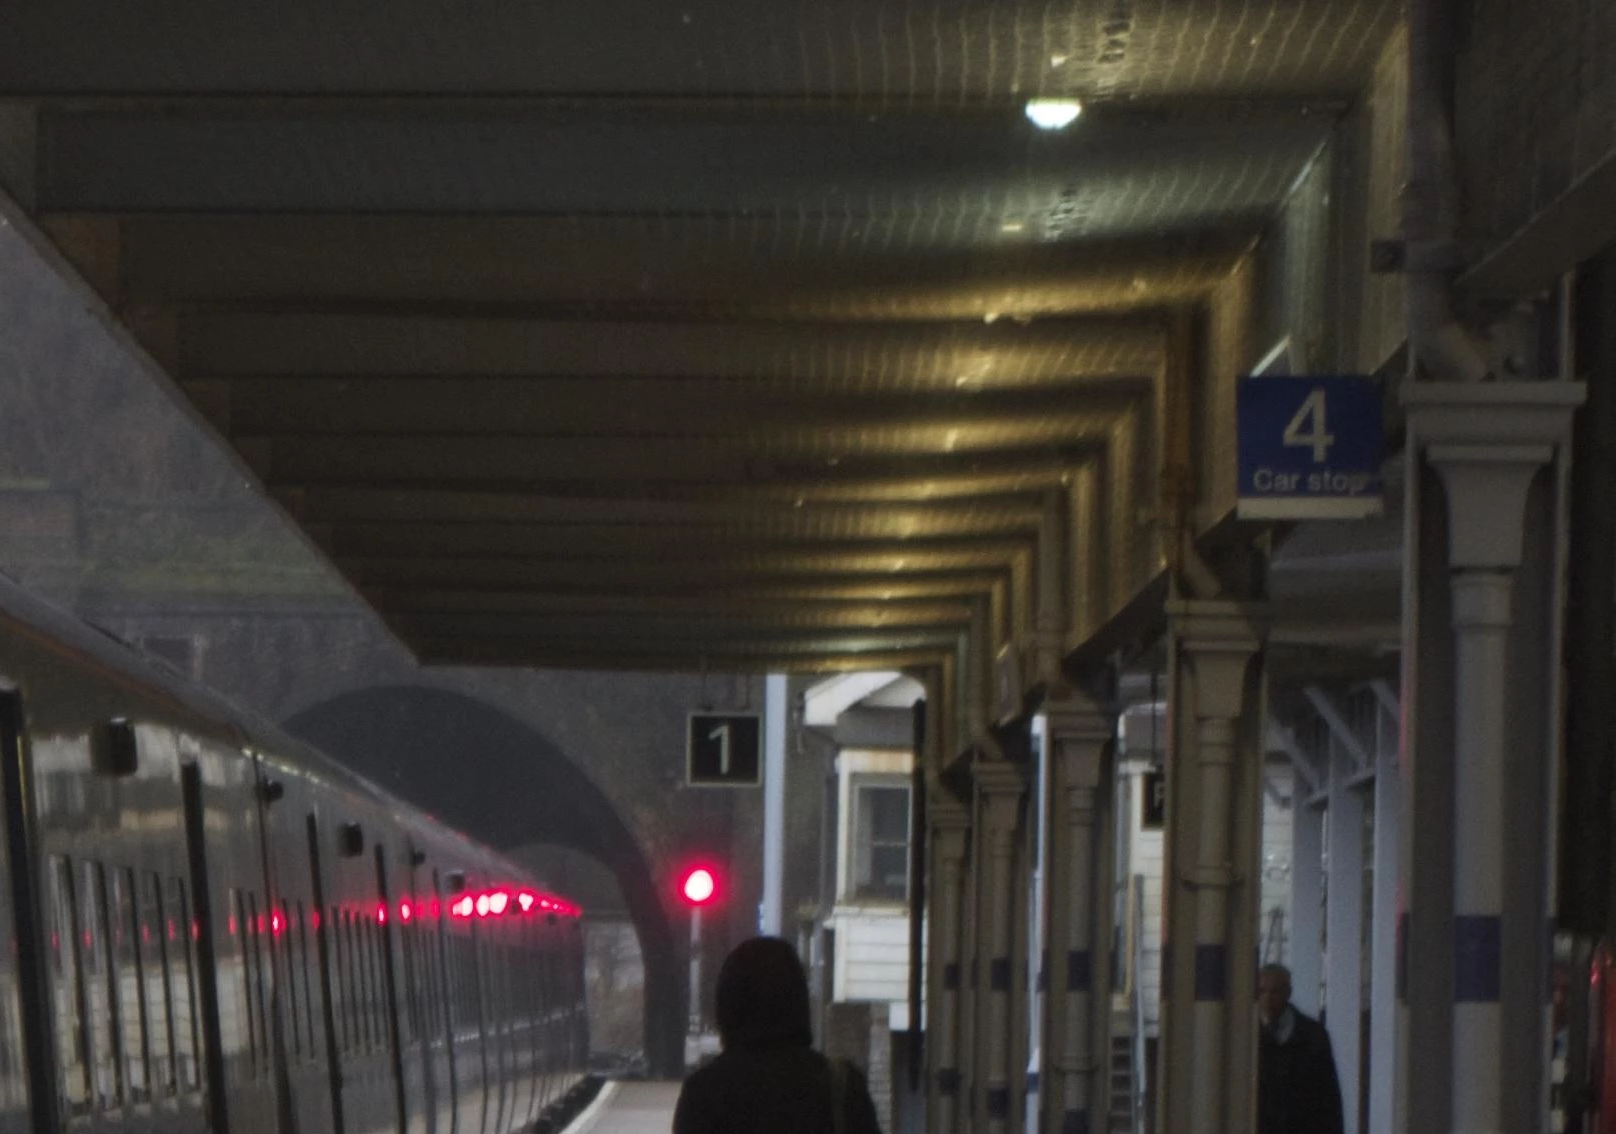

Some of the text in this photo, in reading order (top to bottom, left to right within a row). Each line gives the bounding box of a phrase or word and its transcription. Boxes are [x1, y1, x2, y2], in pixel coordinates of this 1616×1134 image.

[1282, 387, 1336, 464] 4
[1252, 468, 1369, 495] Car stop
[708, 724, 732, 775] 1
